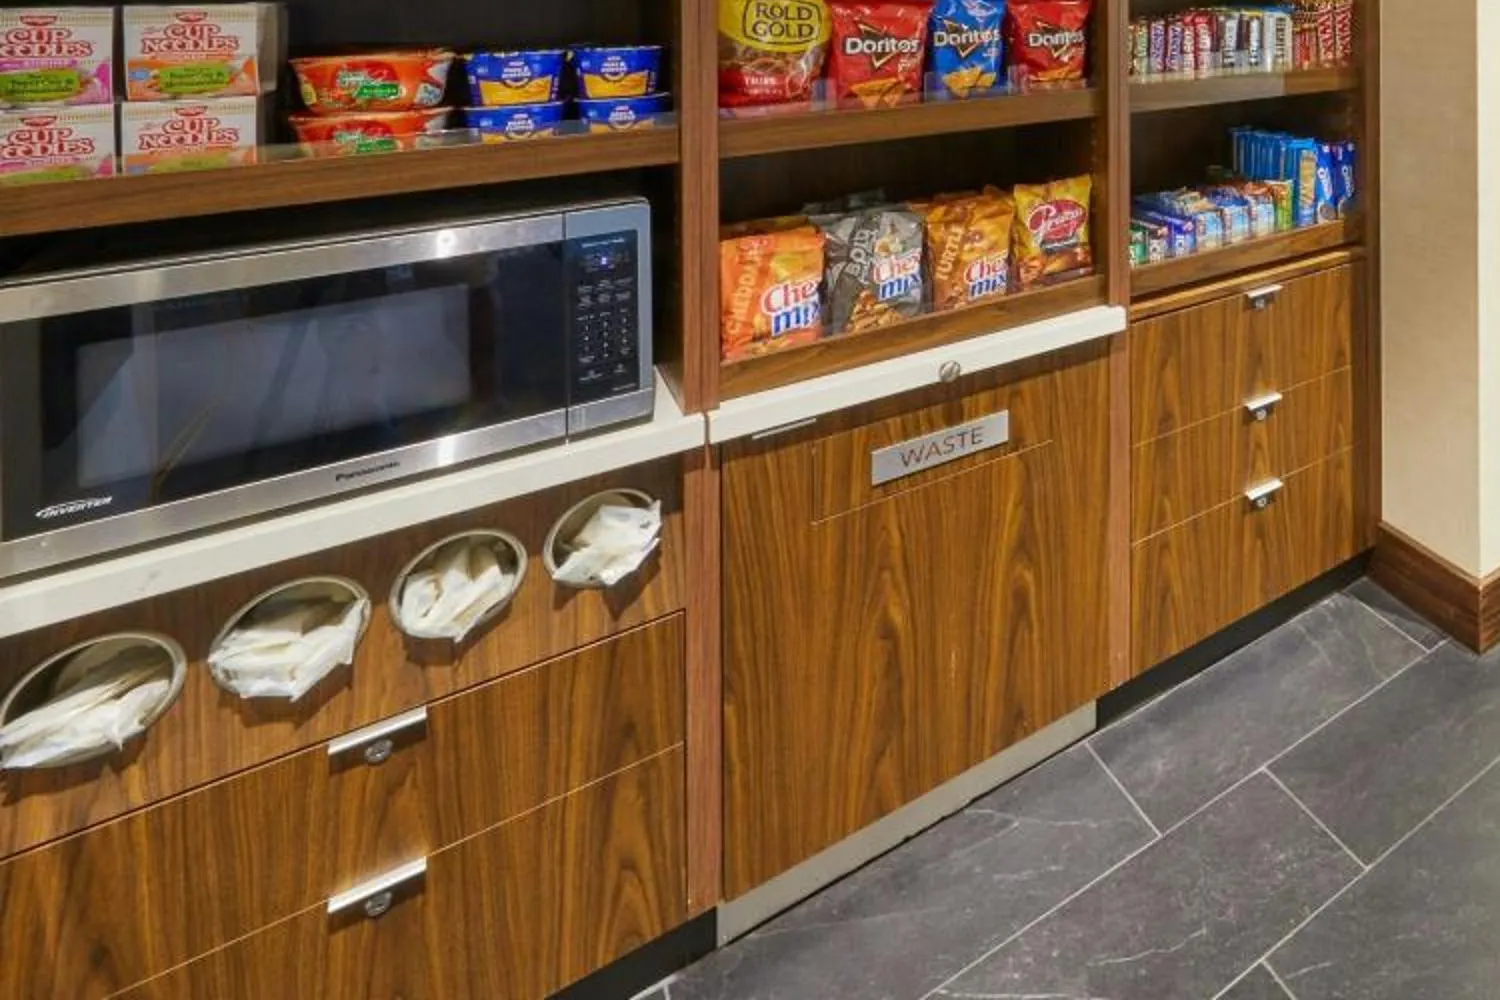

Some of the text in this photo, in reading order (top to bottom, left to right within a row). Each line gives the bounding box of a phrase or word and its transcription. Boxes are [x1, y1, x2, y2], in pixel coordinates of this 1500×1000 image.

[754, 0, 814, 21] ROLD
[6, 27, 73, 45] CUP
[163, 23, 222, 41] CUP
[752, 20, 815, 39] GOLD
[932, 28, 1001, 48] Doritos
[1028, 30, 1085, 49] Doritos
[0, 41, 95, 58] OODLES
[141, 34, 241, 55] NOODLES
[844, 35, 922, 55] Doritos
[7, 127, 74, 146] CUP
[162, 117, 221, 136] CUP
[0, 137, 95, 159] OODLES
[138, 128, 240, 151] NOODLES
[963, 250, 1009, 284] Che
[900, 426, 985, 468] WASTE
